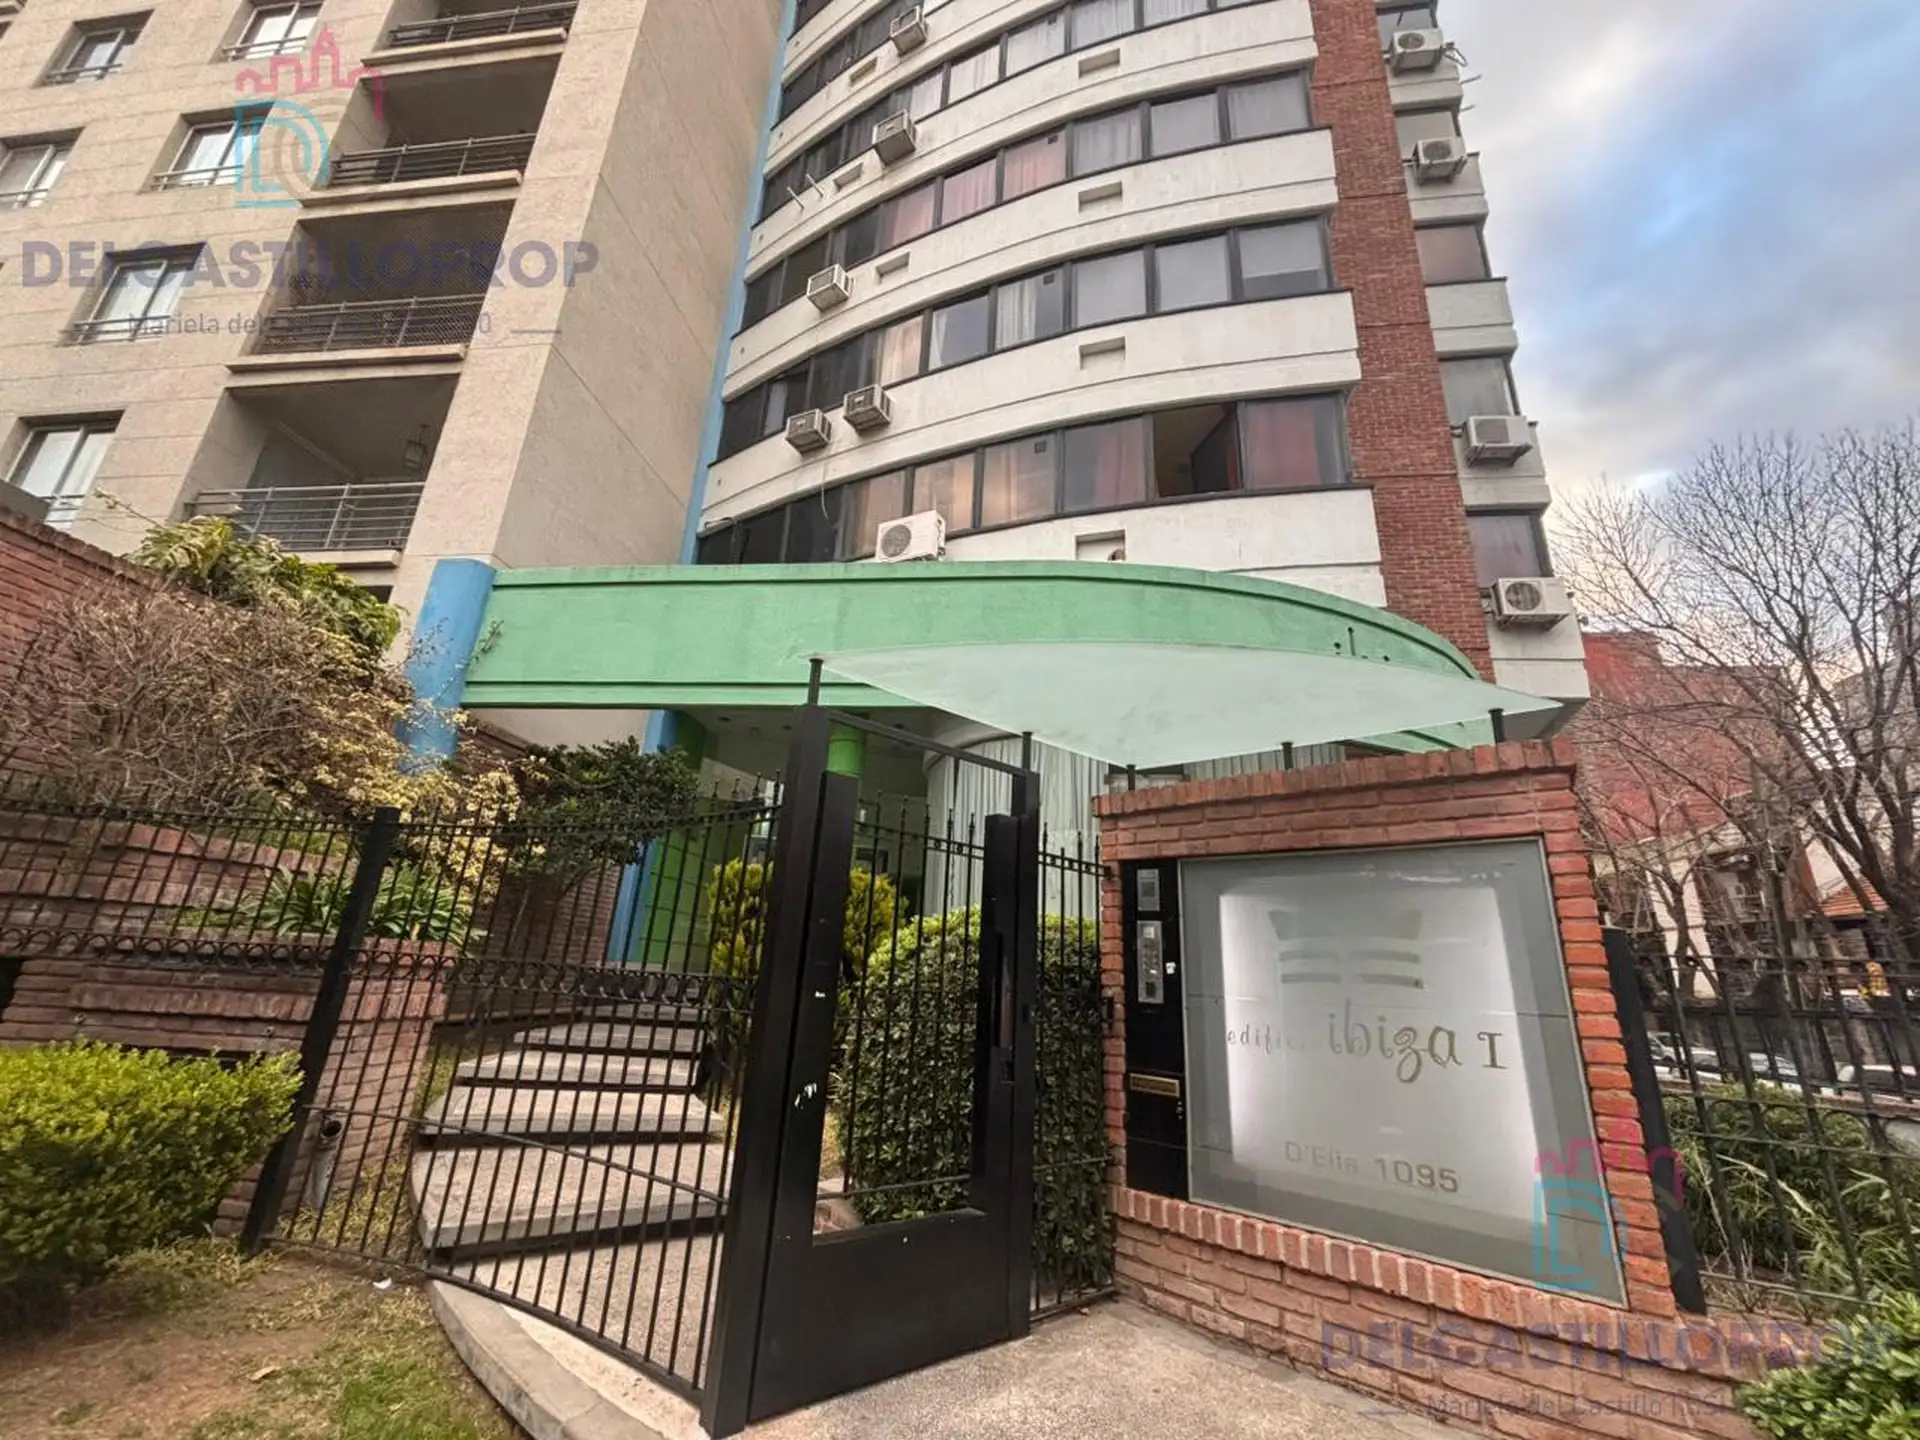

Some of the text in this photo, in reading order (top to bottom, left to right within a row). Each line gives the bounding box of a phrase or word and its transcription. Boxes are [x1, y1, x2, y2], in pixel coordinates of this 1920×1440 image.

[1228, 997, 1510, 1084] edifici ibiza I
[1375, 1157, 1459, 1193] 1095
